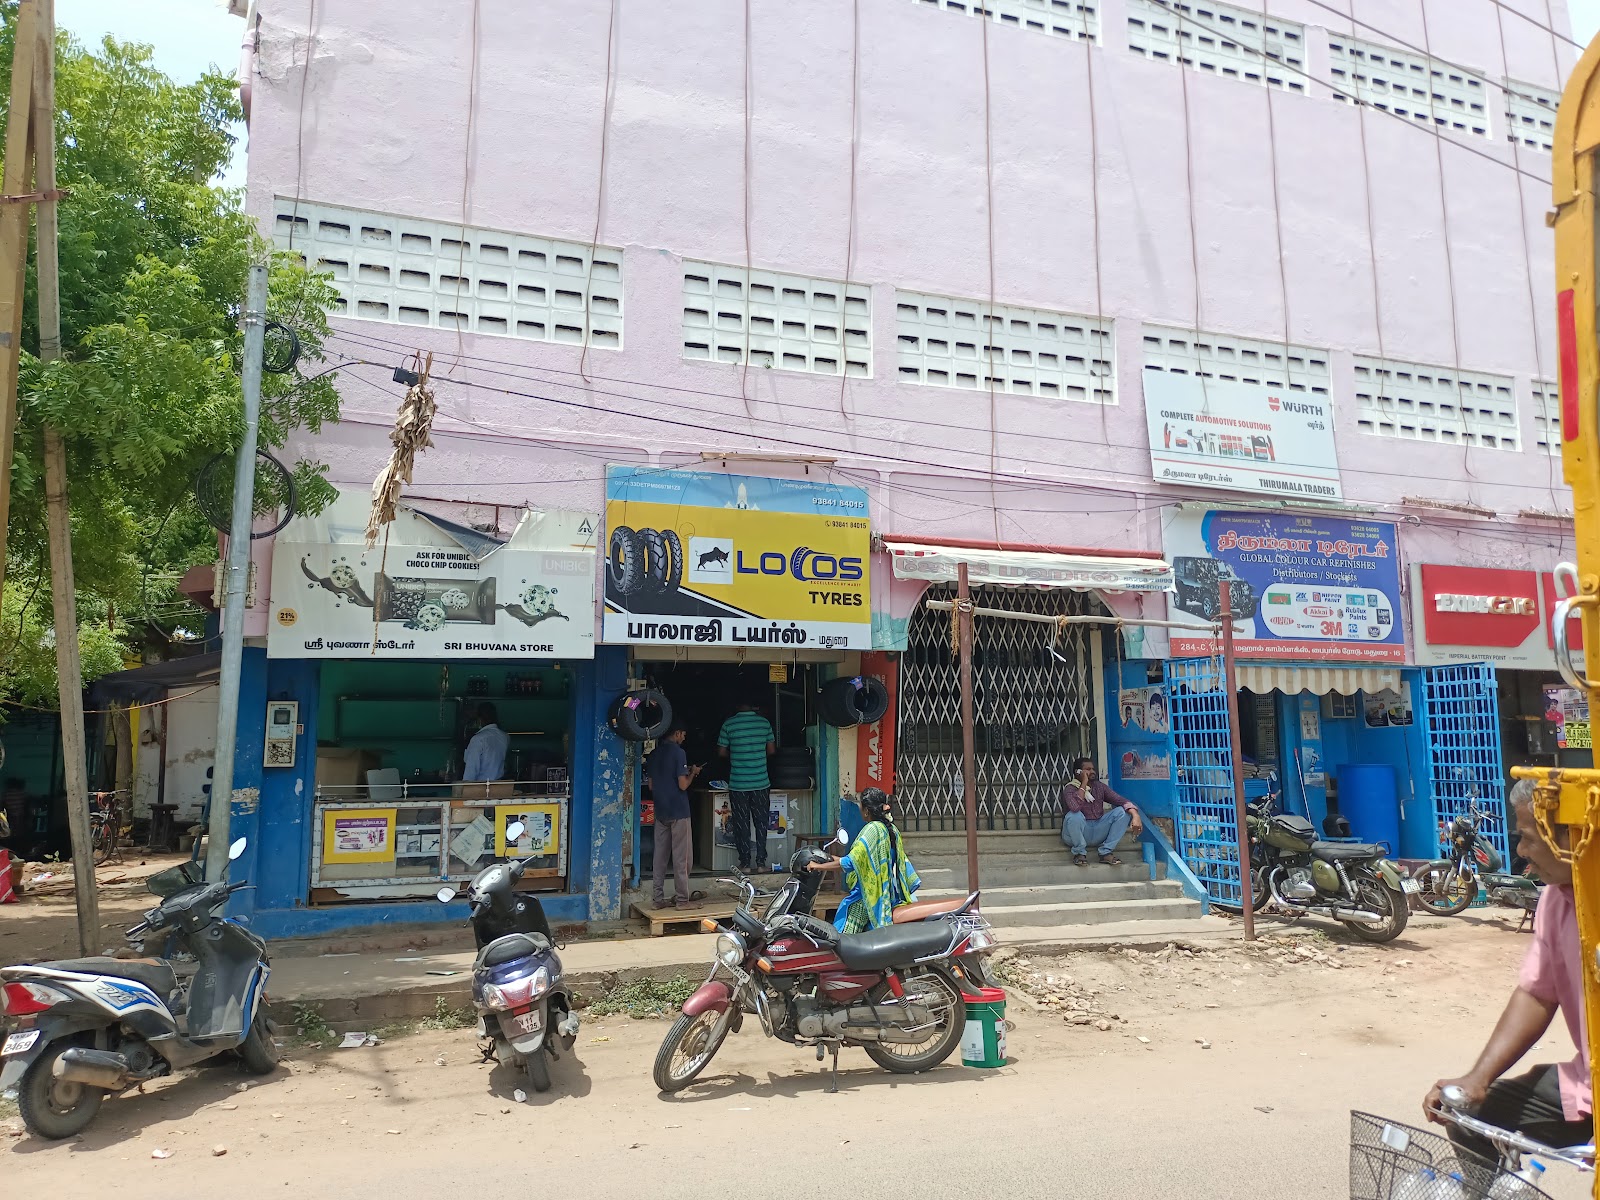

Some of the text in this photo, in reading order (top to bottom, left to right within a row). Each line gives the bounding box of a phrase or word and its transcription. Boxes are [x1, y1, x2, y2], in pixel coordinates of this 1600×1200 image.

[1160, 410, 1272, 431] COMPLETE AUTOMOTIVE SOLUTIONS
[1259, 478, 1335, 496] THIRUMALA TRADERS
[812, 497, 864, 508] 93841 84015
[1217, 529, 1313, 552] திருமலா
[416, 551, 470, 561] ASK FOR UNIBIC
[737, 546, 863, 581] LOCOS
[1239, 554, 1376, 570] GLOBAL COLOUR CAR REFINISHES
[406, 560, 480, 570] CHOCO CHIP COOKIES!
[545, 559, 587, 572] UNIBIC
[1273, 567, 1318, 579] Distributors
[1325, 571, 1357, 581] Stockists
[396, 583, 422, 591] UNIBIC
[808, 591, 862, 606] TYRES
[628, 619, 722, 642] பாலாஜி
[732, 621, 807, 644] டயர்ஸ்
[819, 633, 848, 648] மதுரை
[1320, 621, 1342, 636] 3M
[444, 642, 554, 652] SRI BHUVANA STORE
